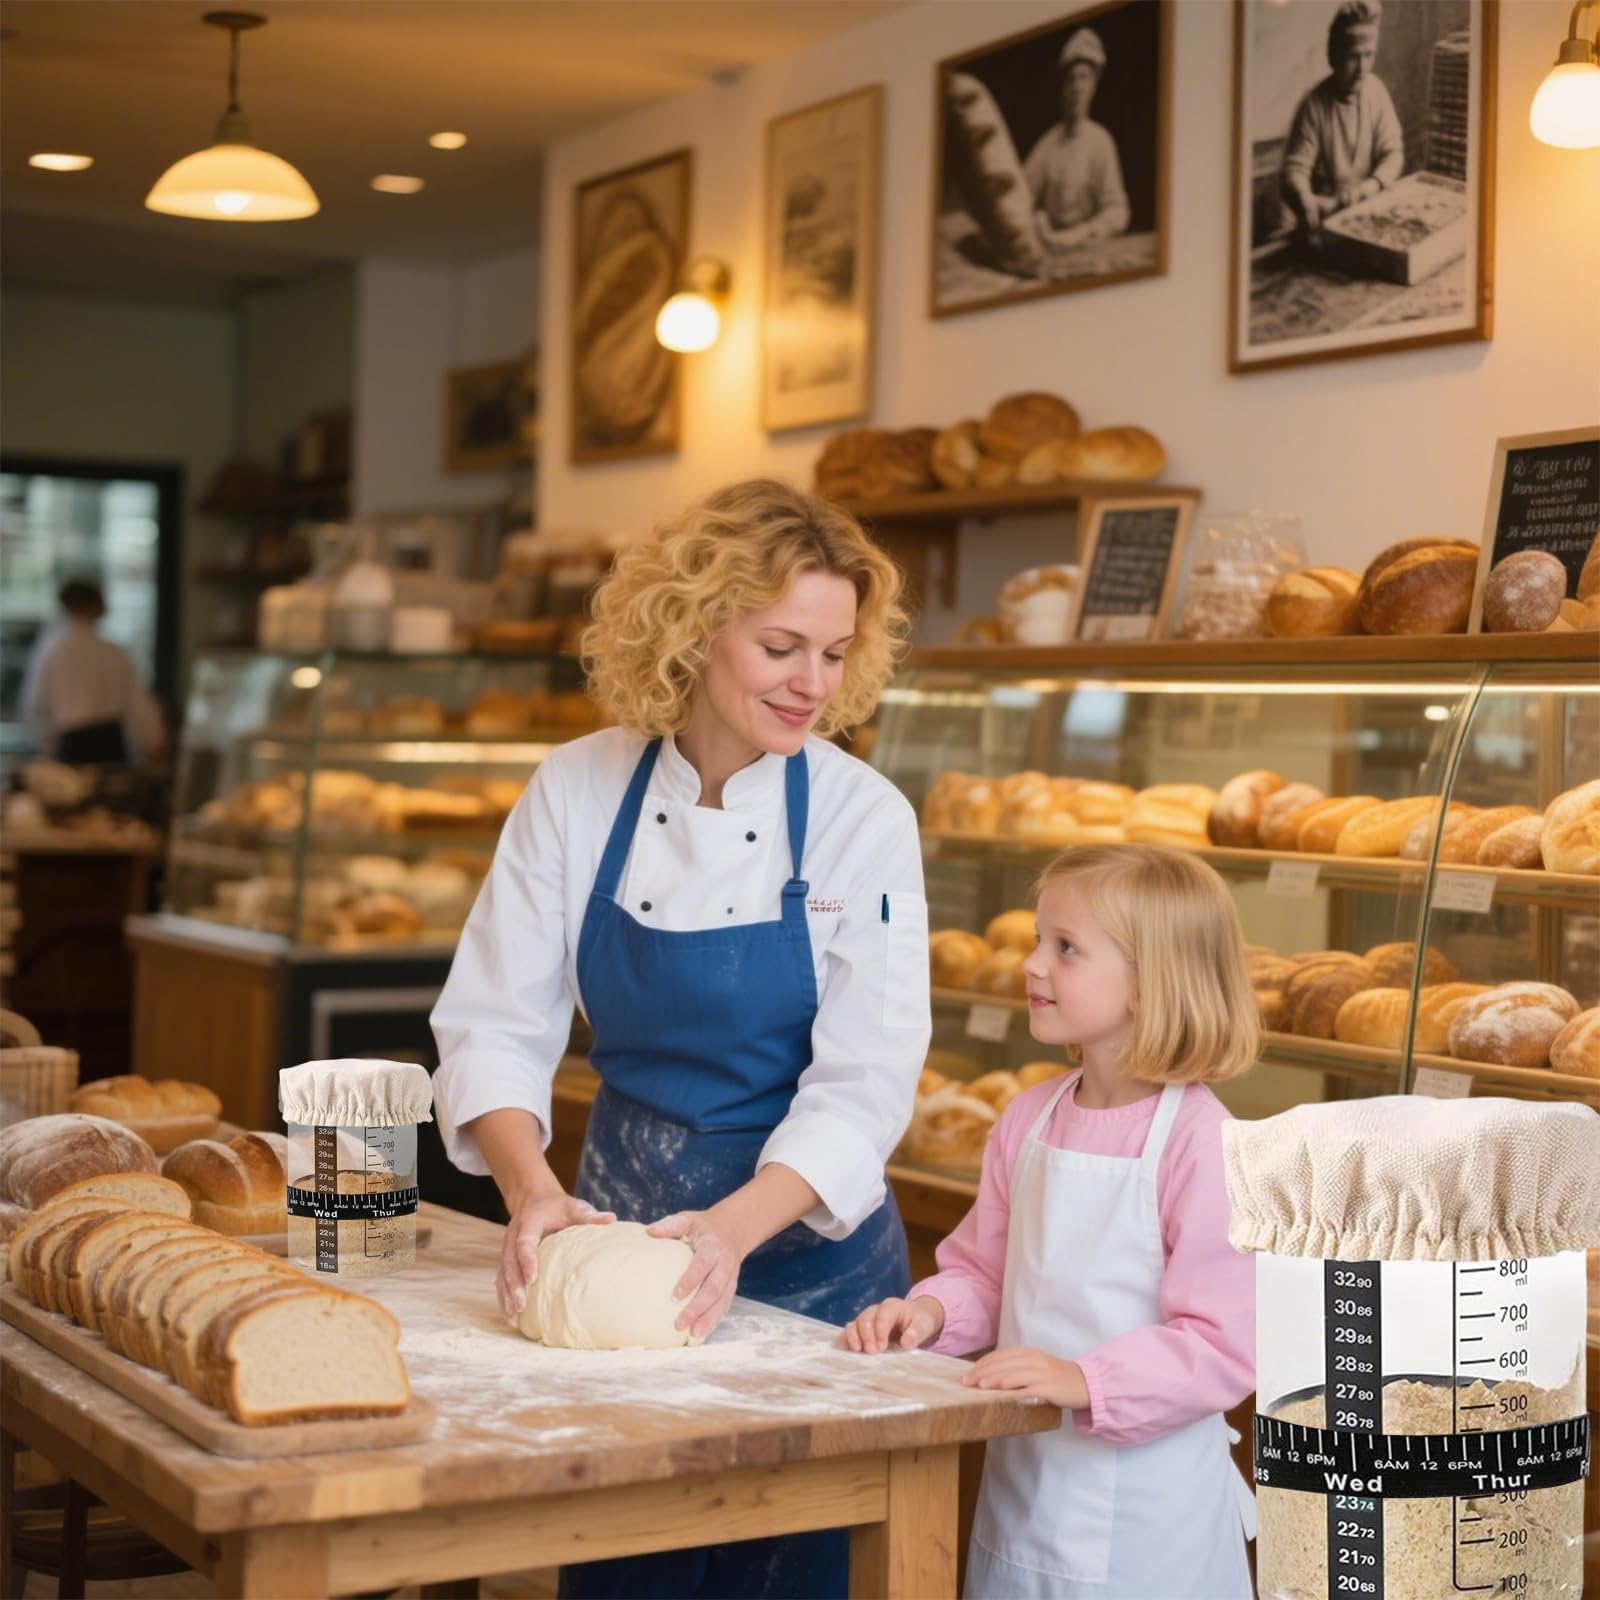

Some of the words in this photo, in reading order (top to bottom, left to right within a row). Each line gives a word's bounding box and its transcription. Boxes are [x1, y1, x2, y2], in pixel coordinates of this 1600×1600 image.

[383, 1141, 395, 1149] 700
[314, 1209, 338, 1218] Wed
[372, 1209, 396, 1217] Thur
[383, 1232, 395, 1240] 200
[1499, 1258, 1528, 1277] 800
[1515, 1275, 1528, 1286] ml
[1499, 1303, 1528, 1323] 700
[1515, 1321, 1528, 1332] ml
[1499, 1348, 1528, 1368] 600
[1515, 1366, 1528, 1377] ml
[1499, 1394, 1528, 1414] 500
[1515, 1411, 1527, 1423] ml
[1262, 1446, 1281, 1460] 6AM
[1287, 1451, 1300, 1462] 12
[1306, 1454, 1336, 1466] 6PM
[1374, 1460, 1410, 1470] 6AM
[1420, 1461, 1438, 1470] 12
[1448, 1461, 1482, 1470] 6PM
[1517, 1455, 1544, 1467] 6AM
[1550, 1451, 1561, 1461] 12
[1324, 1472, 1383, 1492] Wed
[1472, 1474, 1531, 1490] Thur
[1499, 1529, 1528, 1548] 200
[1515, 1548, 1527, 1557] ml
[1499, 1573, 1528, 1592] 100
